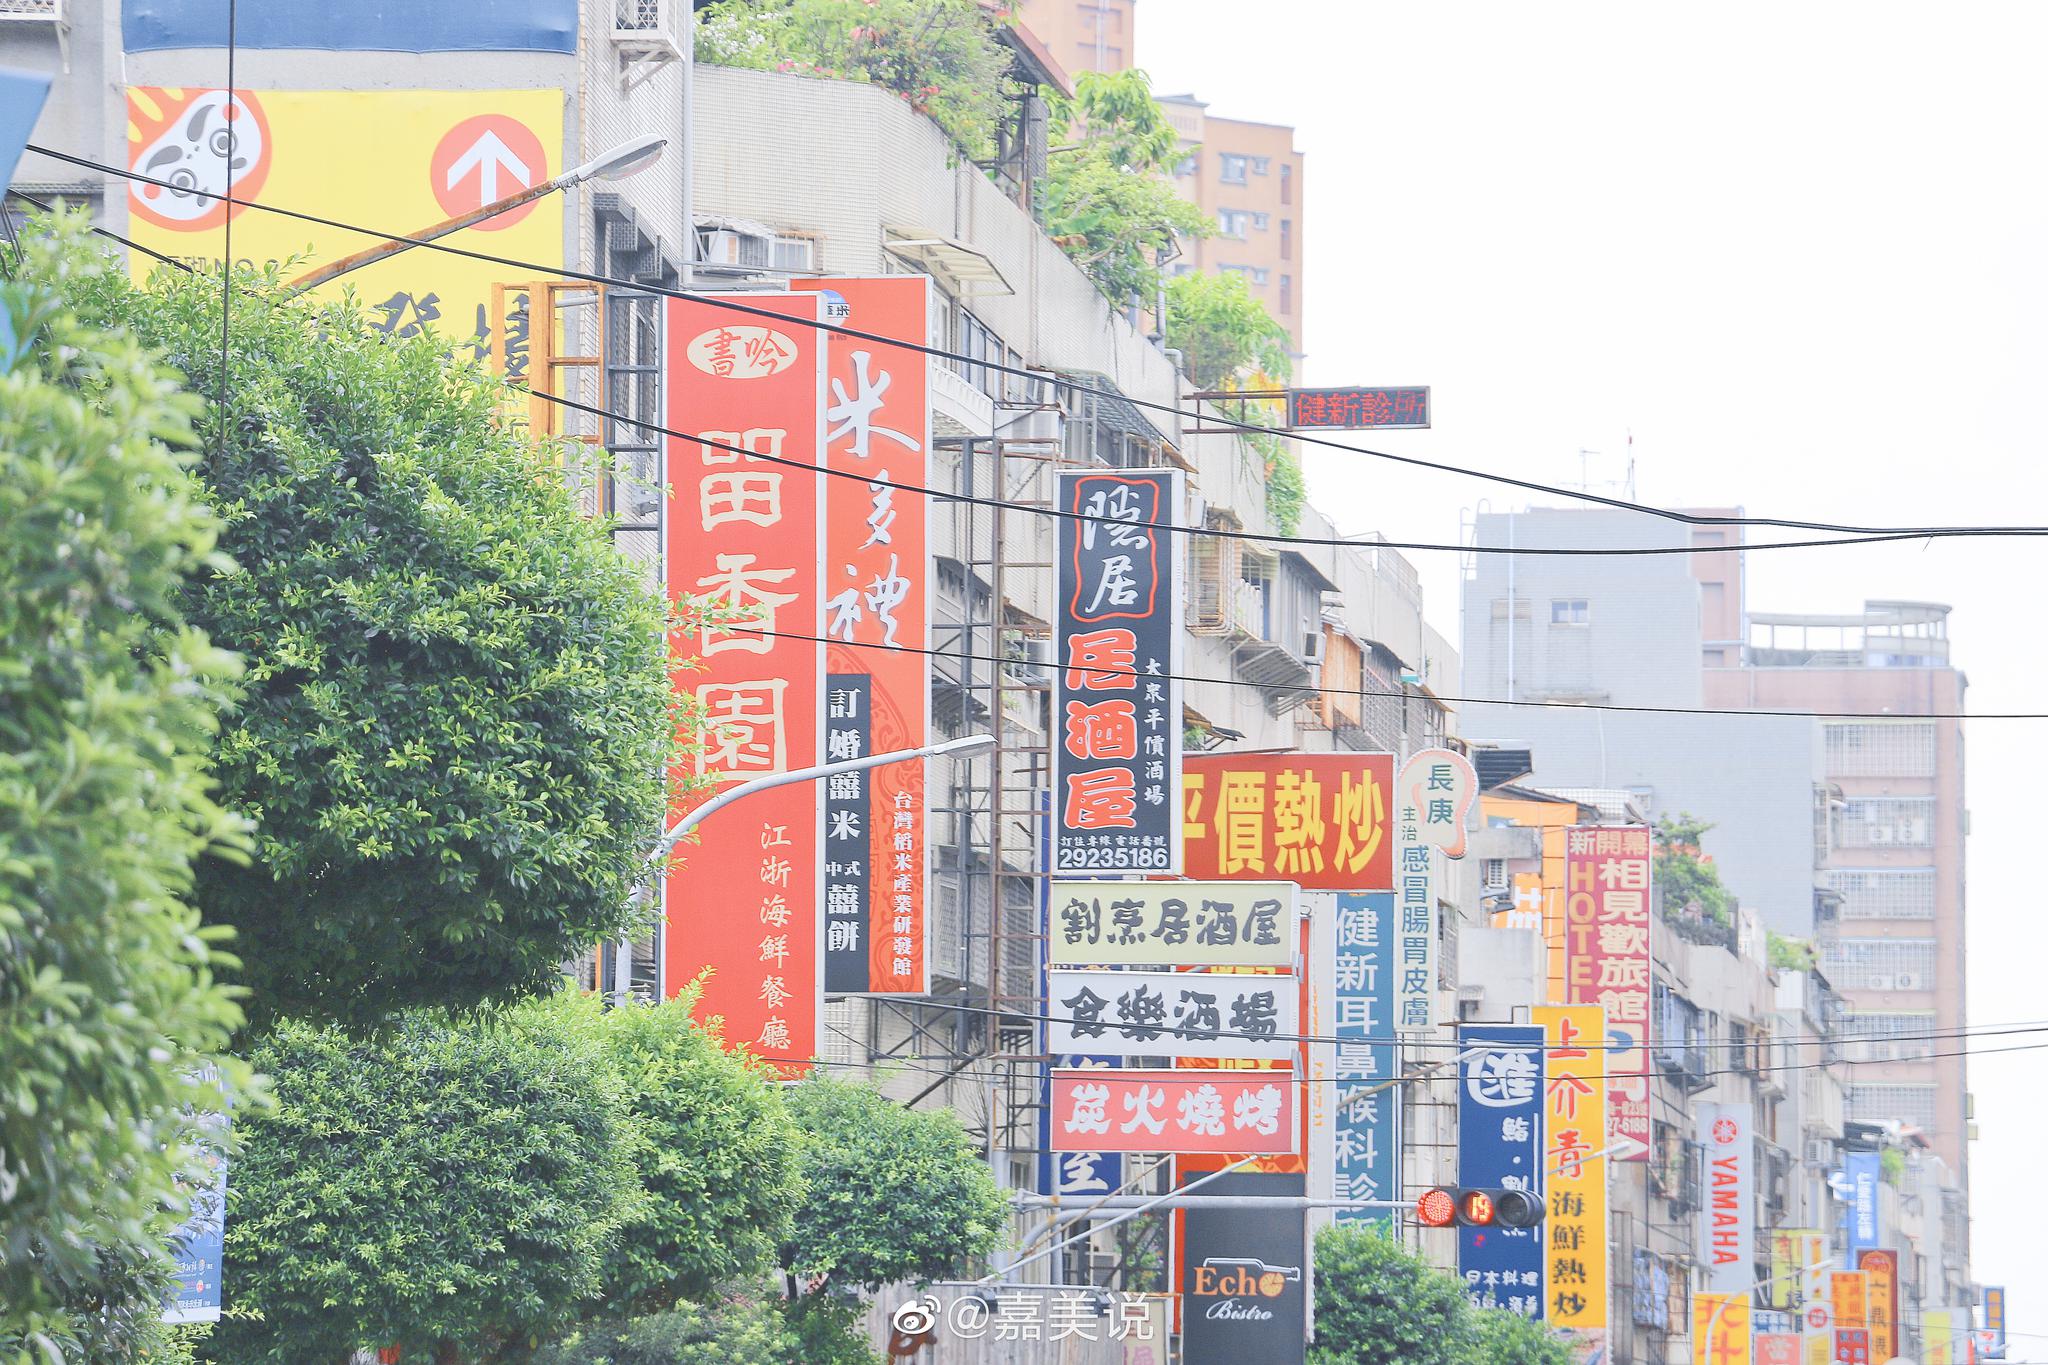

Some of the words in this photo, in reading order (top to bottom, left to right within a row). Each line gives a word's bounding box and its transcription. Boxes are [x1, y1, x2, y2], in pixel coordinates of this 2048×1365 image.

[1296, 391, 1425, 425] 健新診所
[1064, 628, 1138, 829] 居酒屋
[1427, 764, 1455, 824] 長庚
[1059, 847, 1168, 867] 29235186
[1569, 830, 1649, 857] 新開幕
[1061, 897, 1283, 946] 割烹居酒屋
[1401, 844, 1430, 1026] 感冒腸胃皮膚
[1597, 858, 1650, 1022] 相見歡旅館
[1061, 984, 1279, 1043] 食樂酒場
[1335, 906, 1379, 1229] 健新耳鼻喉科診
[1064, 1083, 1283, 1136] 炭火燒烤
[1711, 1155, 1739, 1264] YAMAHA
[1192, 1266, 1287, 1298] Echo
[1552, 1191, 1587, 1317] 海鮮熱炒
[1205, 1298, 1274, 1321] Bistro
